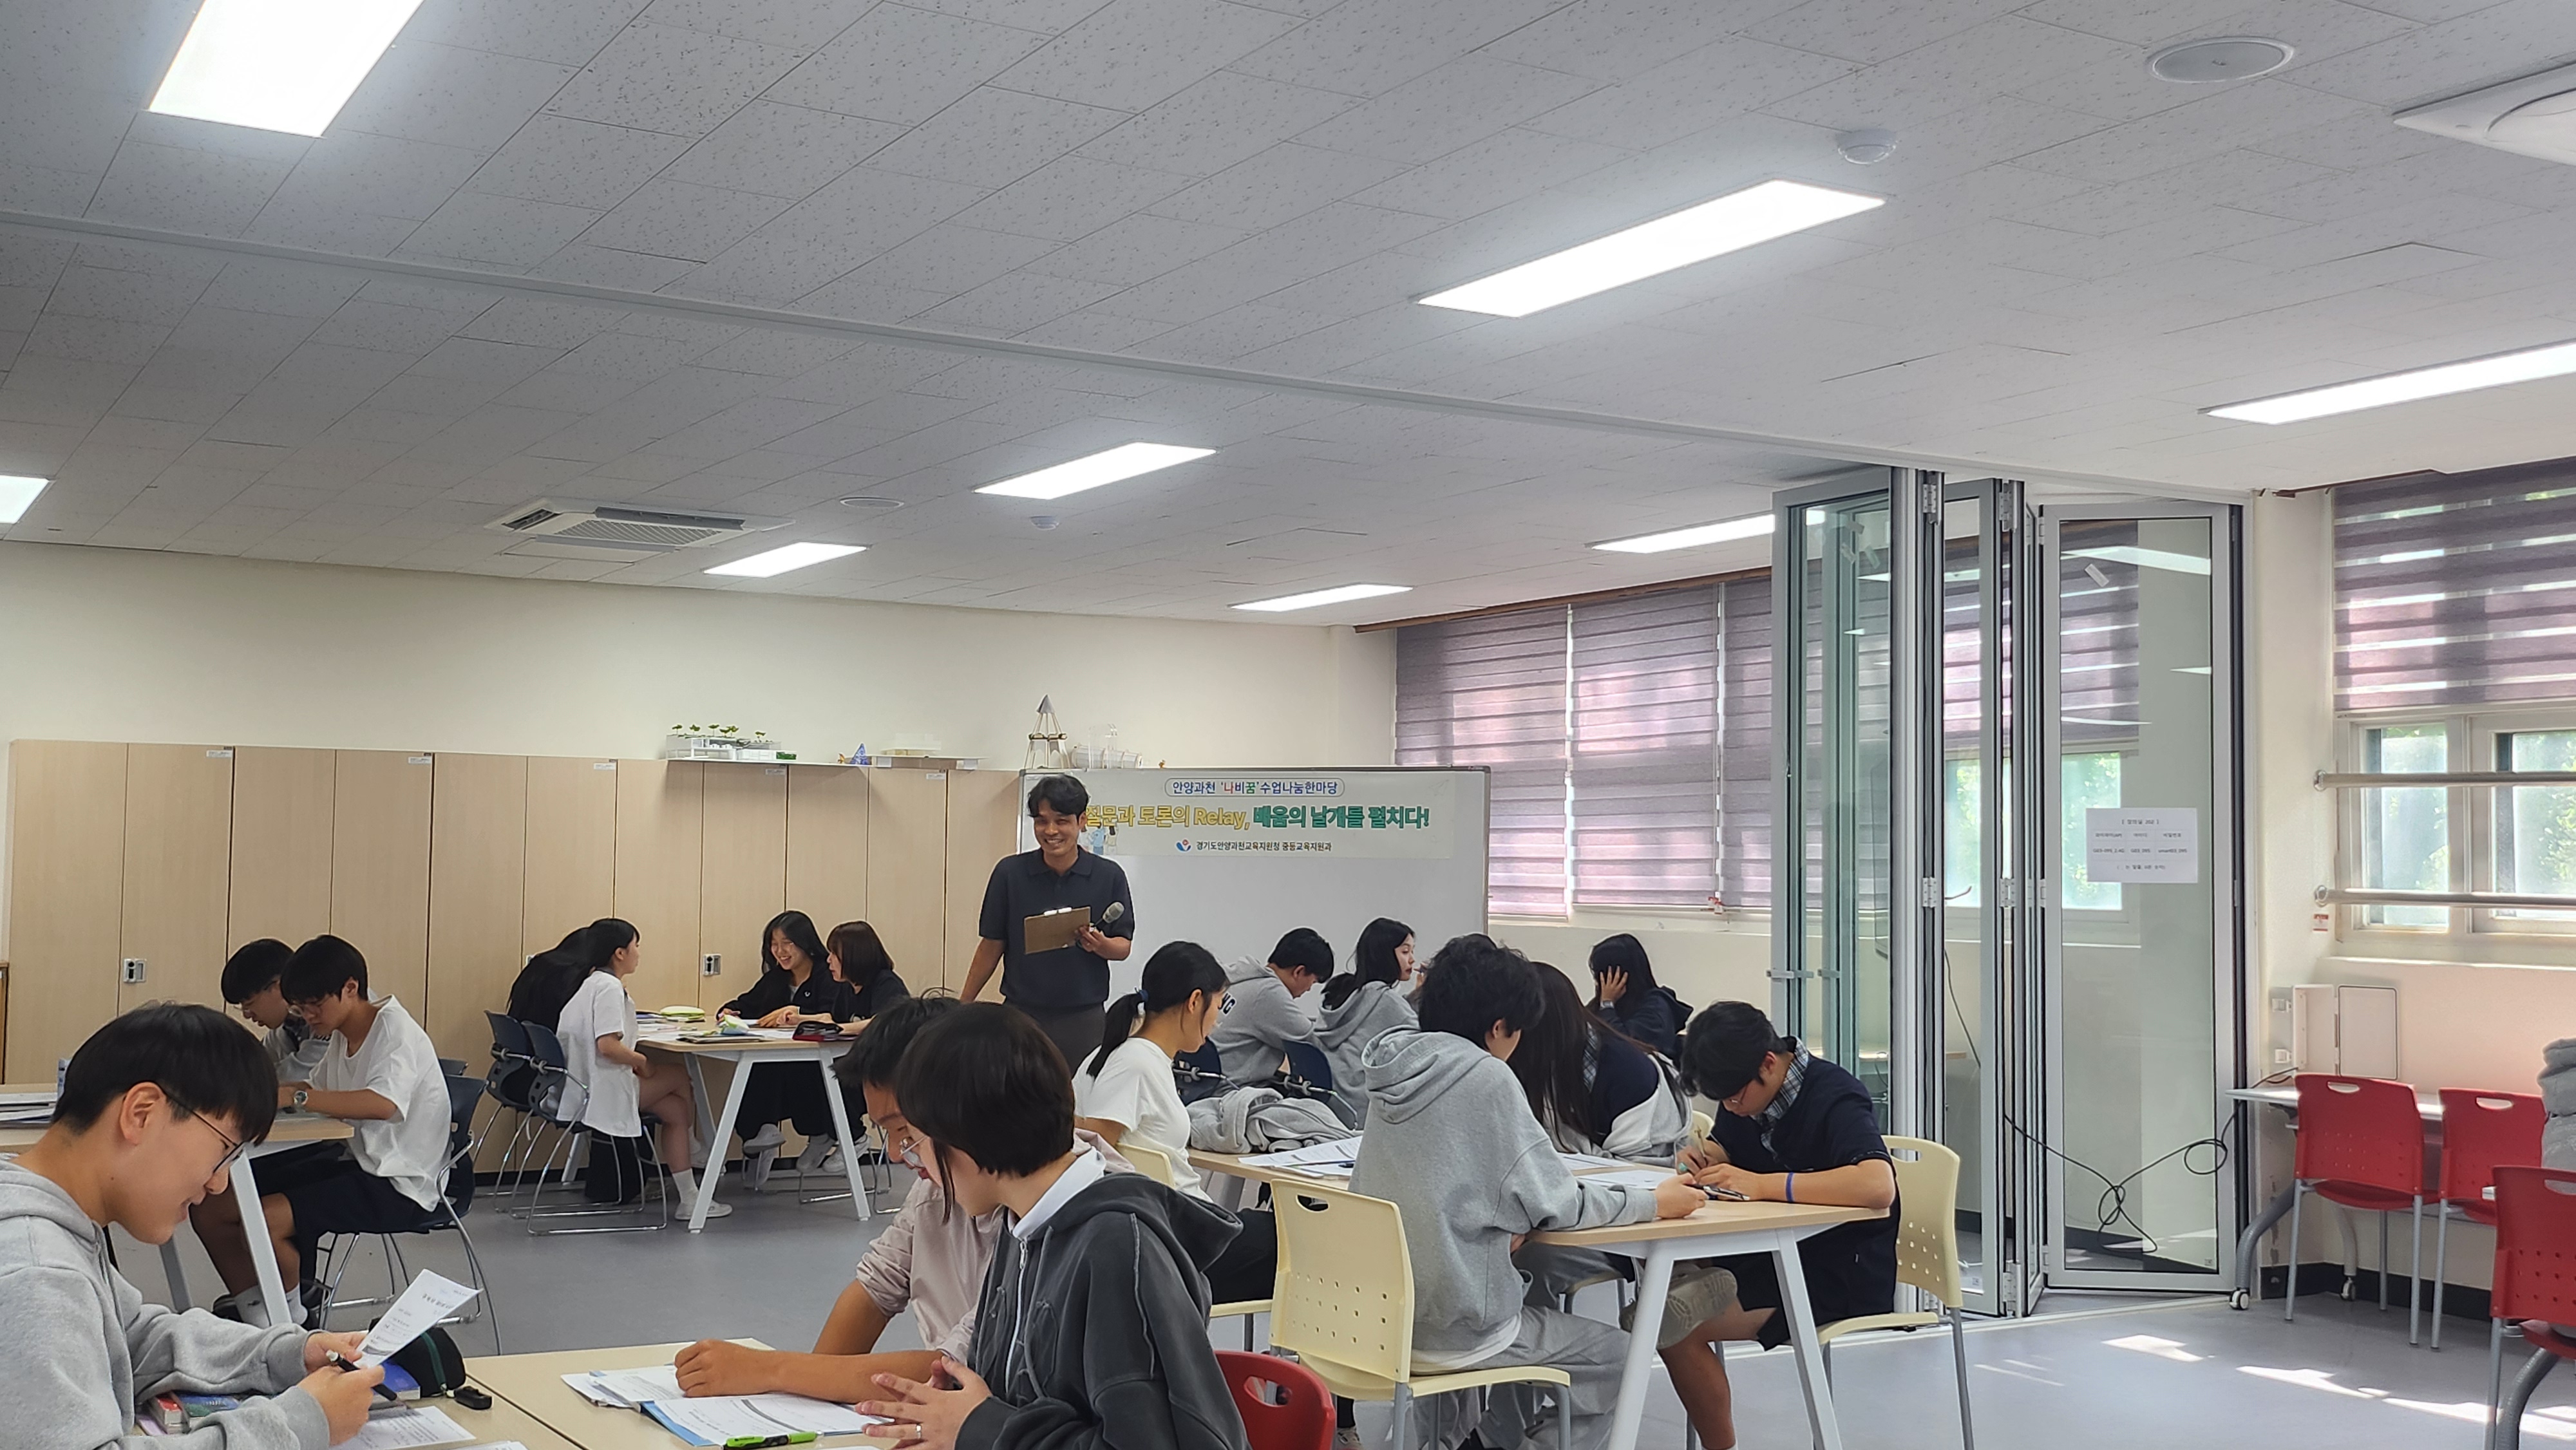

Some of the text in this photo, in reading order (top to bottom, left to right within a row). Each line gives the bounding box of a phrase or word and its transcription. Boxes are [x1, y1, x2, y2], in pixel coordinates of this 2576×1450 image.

[1173, 781, 1215, 795] 안양과천
[1138, 805, 1190, 827] 토론의
[1194, 807, 1250, 831] Relay,
[1253, 805, 1307, 829] 배움의
[1310, 805, 1365, 829] 날개를
[1368, 805, 1430, 829] 펼치다!
[1196, 841, 1332, 852] 경기도안양과천교육지원청 중등교육지원과
